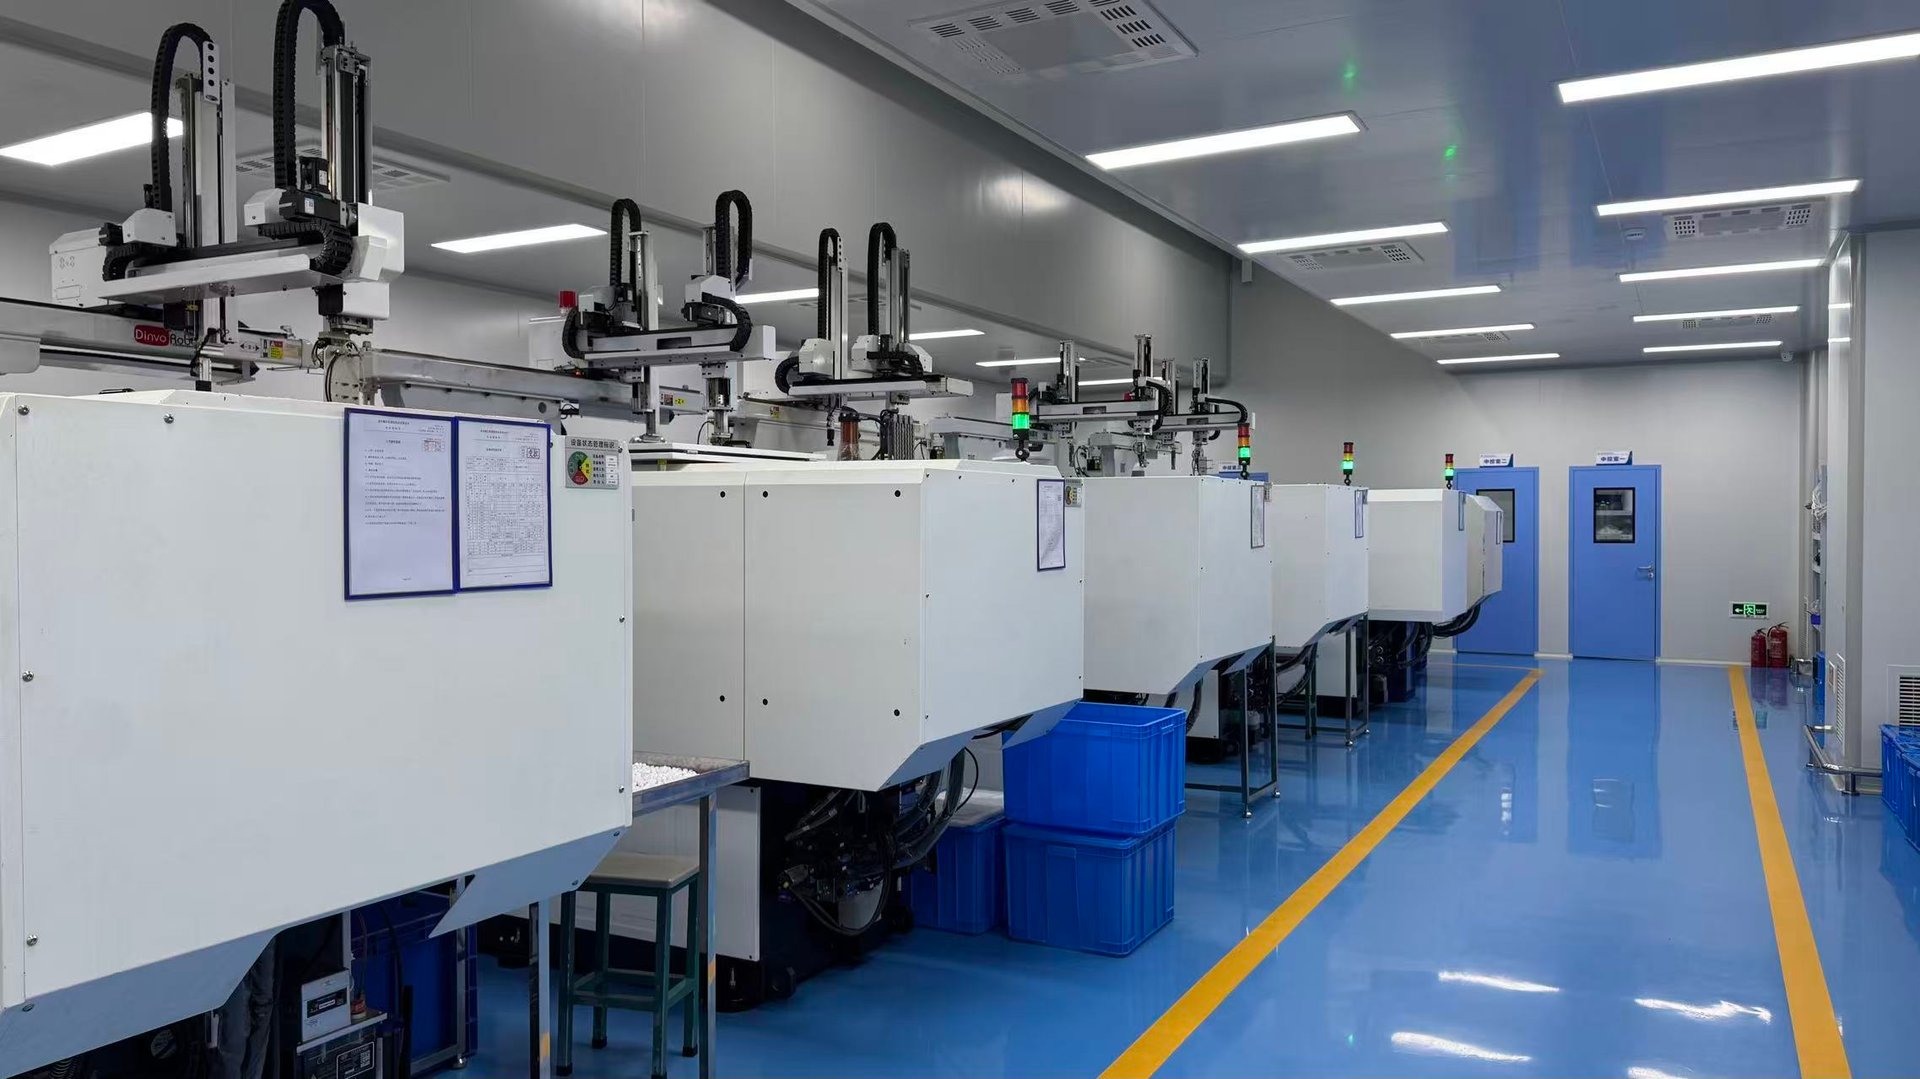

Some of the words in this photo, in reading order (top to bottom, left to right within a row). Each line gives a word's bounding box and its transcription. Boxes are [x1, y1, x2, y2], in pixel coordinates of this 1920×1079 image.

[135, 328, 167, 343] Dinvo
[170, 333, 194, 346] Rob
[570, 439, 615, 448] 设备状态管理标识
